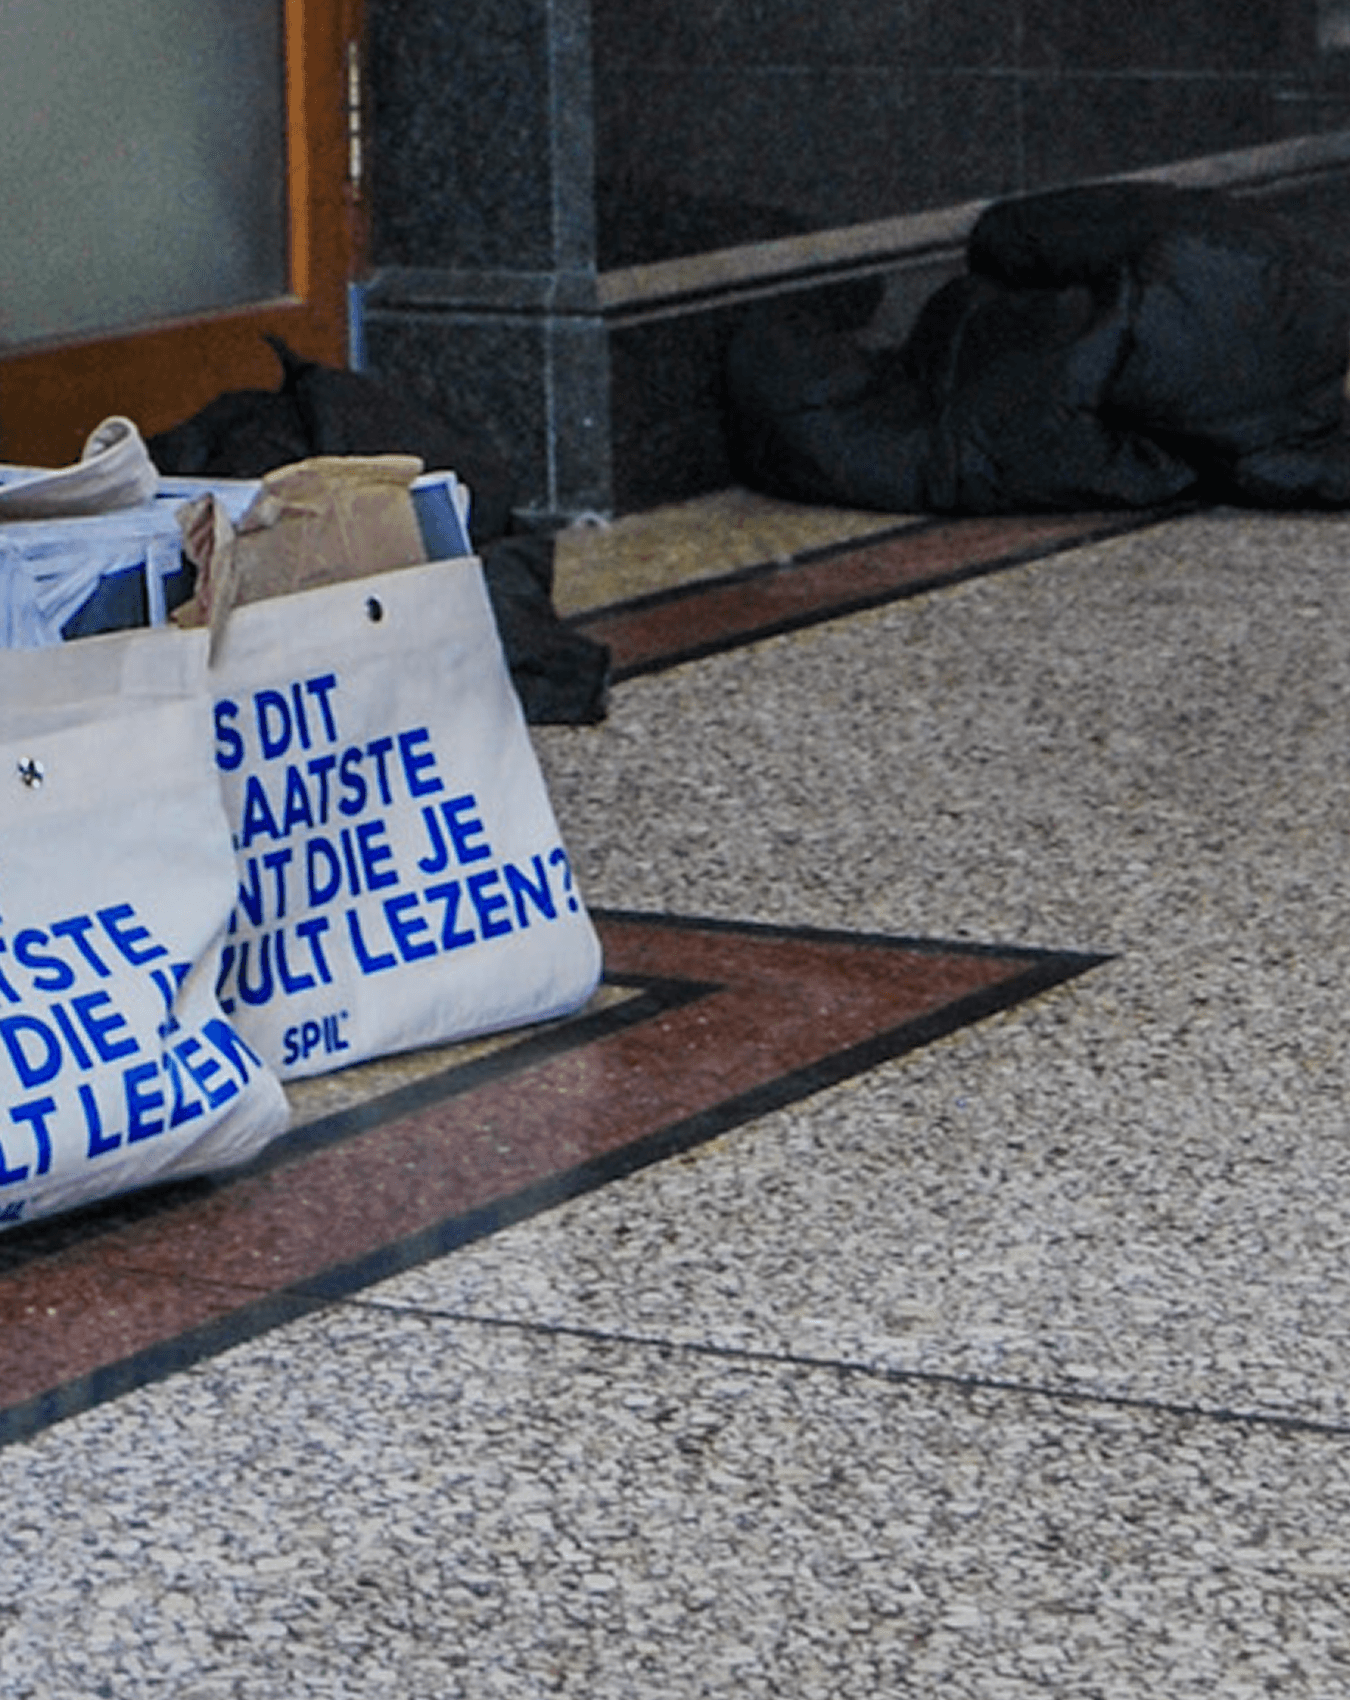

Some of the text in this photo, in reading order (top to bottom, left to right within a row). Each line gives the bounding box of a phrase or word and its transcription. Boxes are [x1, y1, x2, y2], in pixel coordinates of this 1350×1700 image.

[211, 671, 340, 775] S DIT
[233, 725, 447, 853] AATSTE
[303, 818, 401, 910] DIE
[415, 793, 494, 878] JE
[344, 846, 580, 976] LEZEN?
